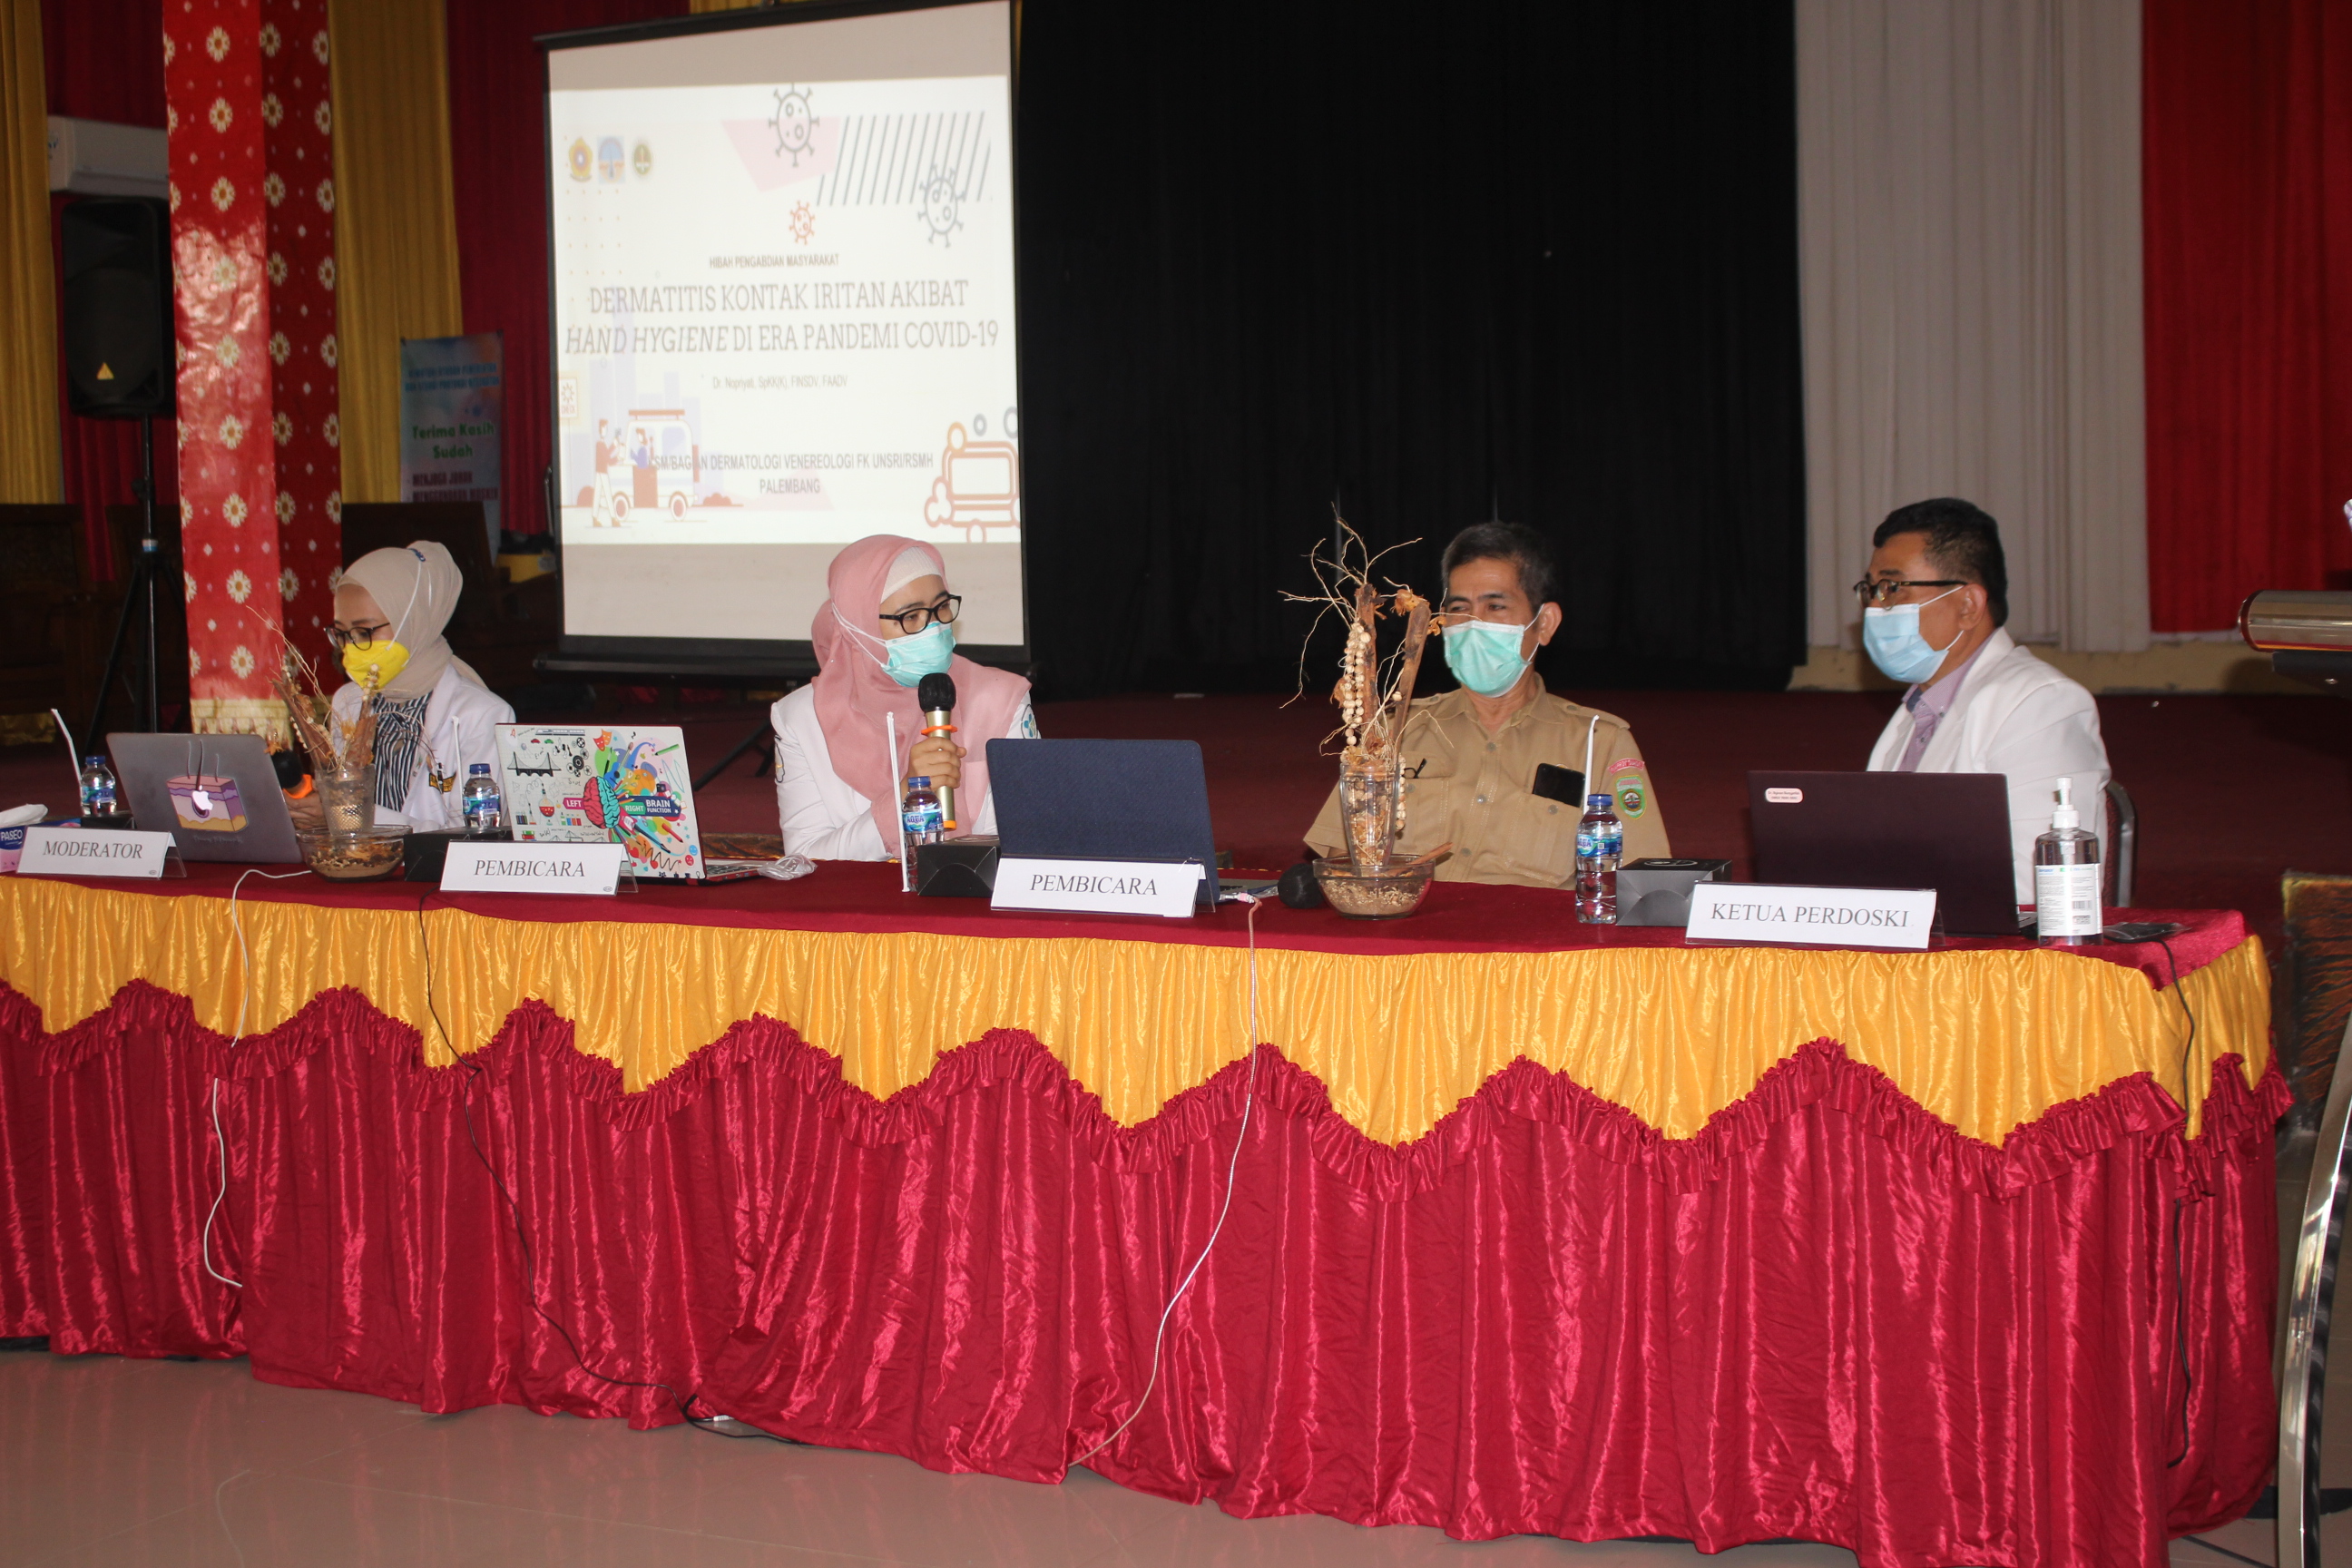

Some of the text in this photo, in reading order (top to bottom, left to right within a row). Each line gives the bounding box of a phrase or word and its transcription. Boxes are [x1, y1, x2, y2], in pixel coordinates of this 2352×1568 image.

[710, 253, 839, 269] HIBAH PENGABDIAN MASYARAKAT
[590, 279, 969, 314] DERMATITIS KONTAK IRITAN AKIBAT
[565, 319, 999, 355] HAND HYGIENE DI ERA PANDEMI COVID-19
[822, 373, 848, 387] FAADV
[412, 422, 495, 439] Terima Kasih
[433, 444, 473, 459] Sudah
[710, 455, 782, 470] DERMATOLOGI
[785, 454, 854, 469] VENEREOLOGI
[857, 454, 870, 468] FK
[873, 453, 934, 468] UNSRI/RSMH
[760, 478, 821, 494] PALEMBANG
[566, 799, 582, 808] LEFT
[645, 799, 671, 808] BRAIN
[1, 829, 24, 841] PASEO
[43, 840, 143, 858] MODERATOR
[474, 859, 585, 877] PEMBICARA
[1030, 874, 1158, 896] PEMBICARA
[1710, 903, 1910, 927] KETUA PERDOSKI
